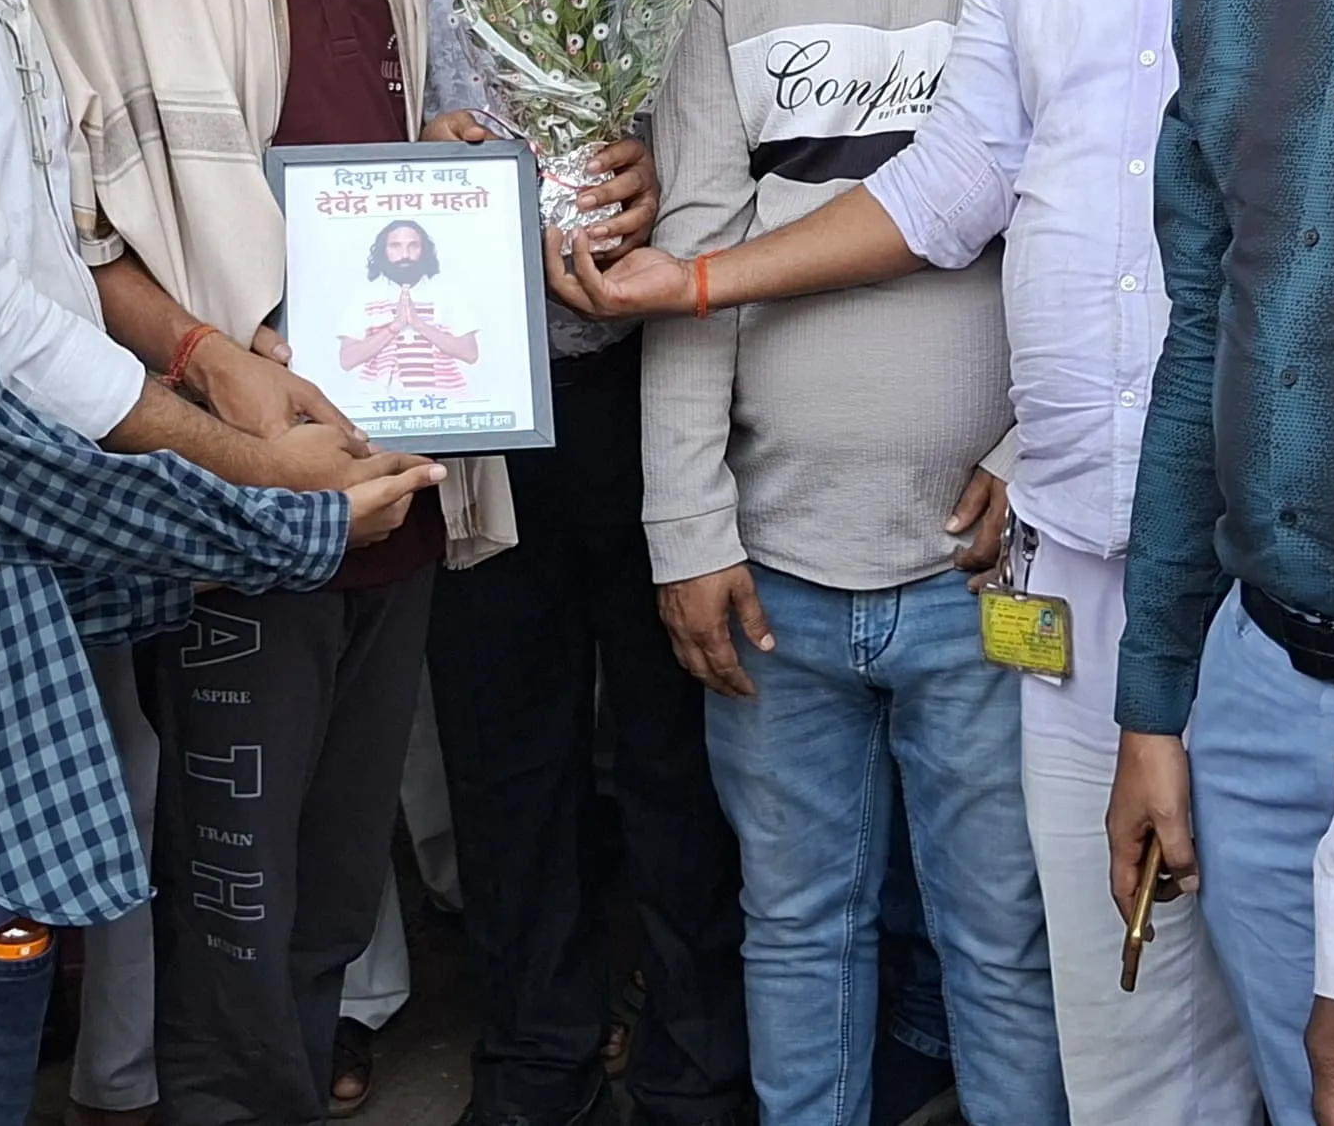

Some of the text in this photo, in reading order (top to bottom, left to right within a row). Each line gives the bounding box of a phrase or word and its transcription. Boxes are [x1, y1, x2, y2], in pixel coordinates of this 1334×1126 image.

[334, 168, 388, 191] दिशुम
[393, 164, 426, 184] वीर
[315, 186, 490, 215] देवेंद्र नाथ महतो
[371, 393, 449, 413] सप्रेम भेंट
[192, 687, 251, 704] ASPIRE
[197, 825, 253, 847] TRAIN
